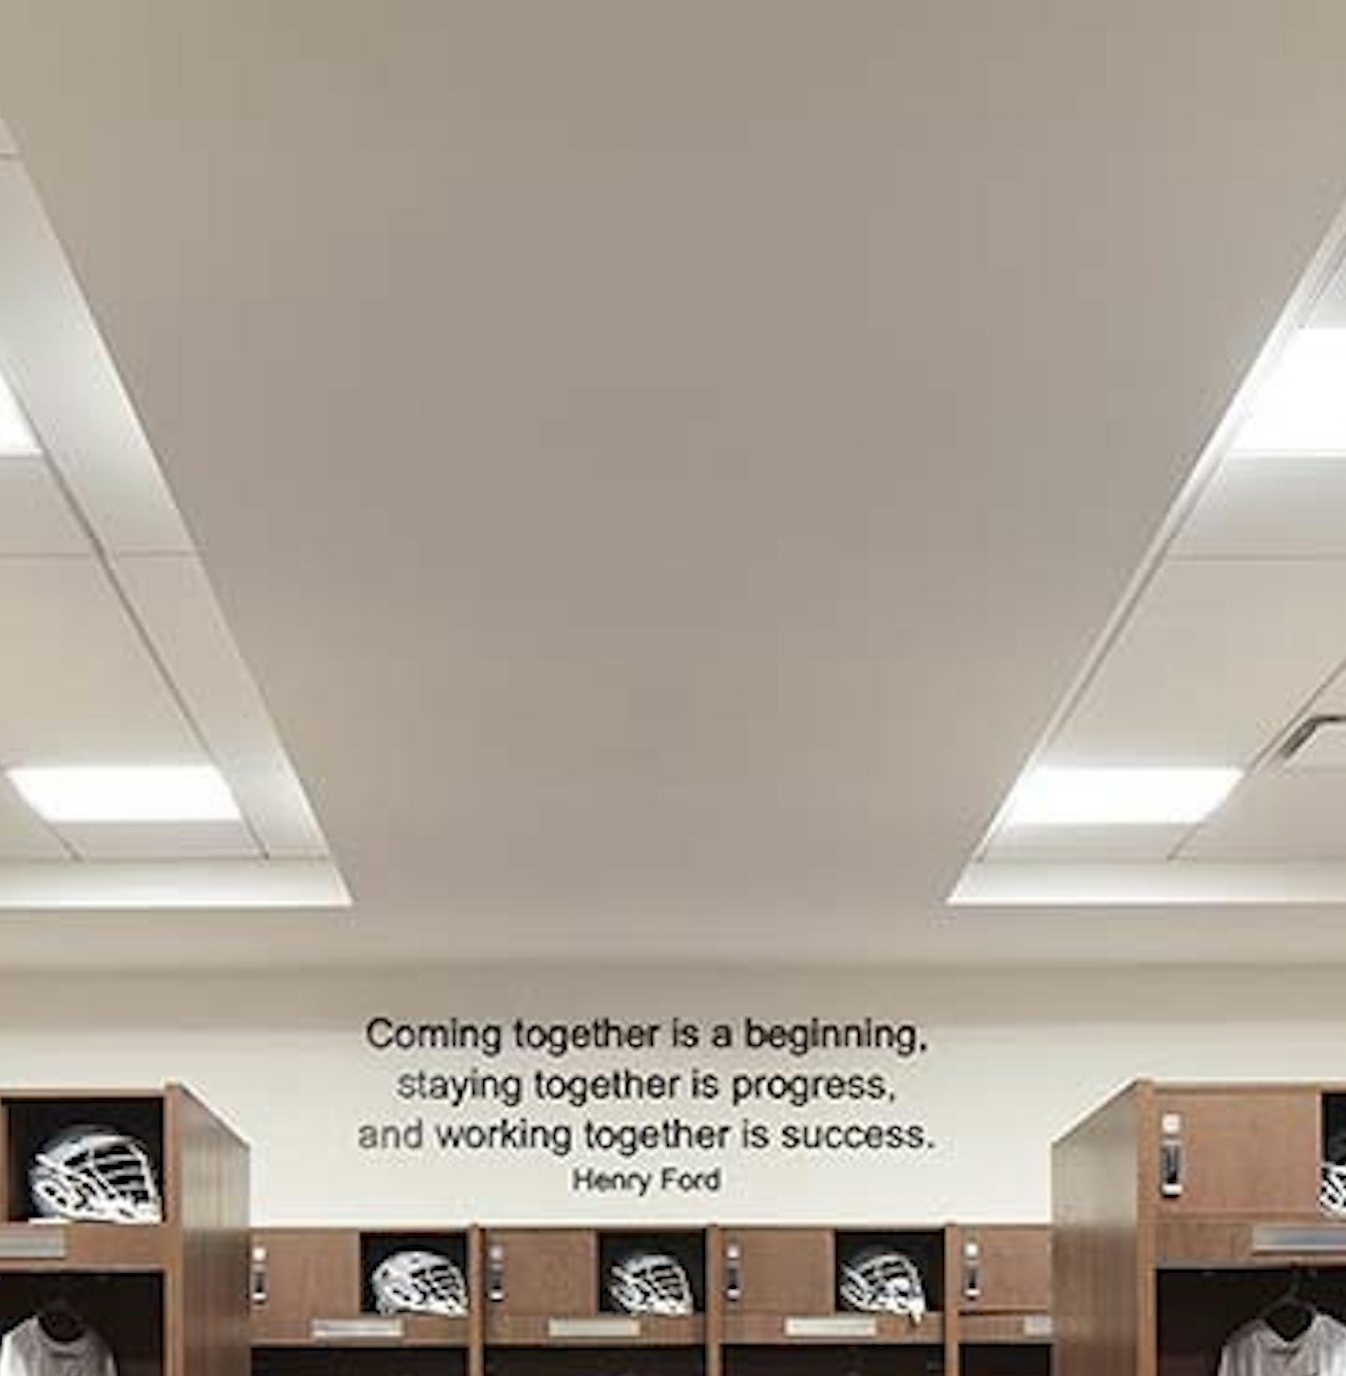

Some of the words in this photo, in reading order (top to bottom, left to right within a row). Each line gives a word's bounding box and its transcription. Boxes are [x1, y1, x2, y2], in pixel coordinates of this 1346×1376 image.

[366, 1017, 502, 1056] Coming
[514, 1018, 658, 1056] together
[671, 1017, 700, 1050] is
[711, 1025, 732, 1050] a
[744, 1017, 928, 1056] beginning,
[396, 1069, 522, 1107] staying
[534, 1069, 679, 1107] together
[690, 1069, 720, 1100] is
[732, 1076, 896, 1107] progress,
[358, 1119, 423, 1150] and
[435, 1119, 572, 1157] working
[584, 1119, 729, 1157] together
[742, 1119, 770, 1150] is
[781, 1127, 936, 1150] success.
[572, 1167, 652, 1197] Henry
[660, 1167, 722, 1192] Ford
